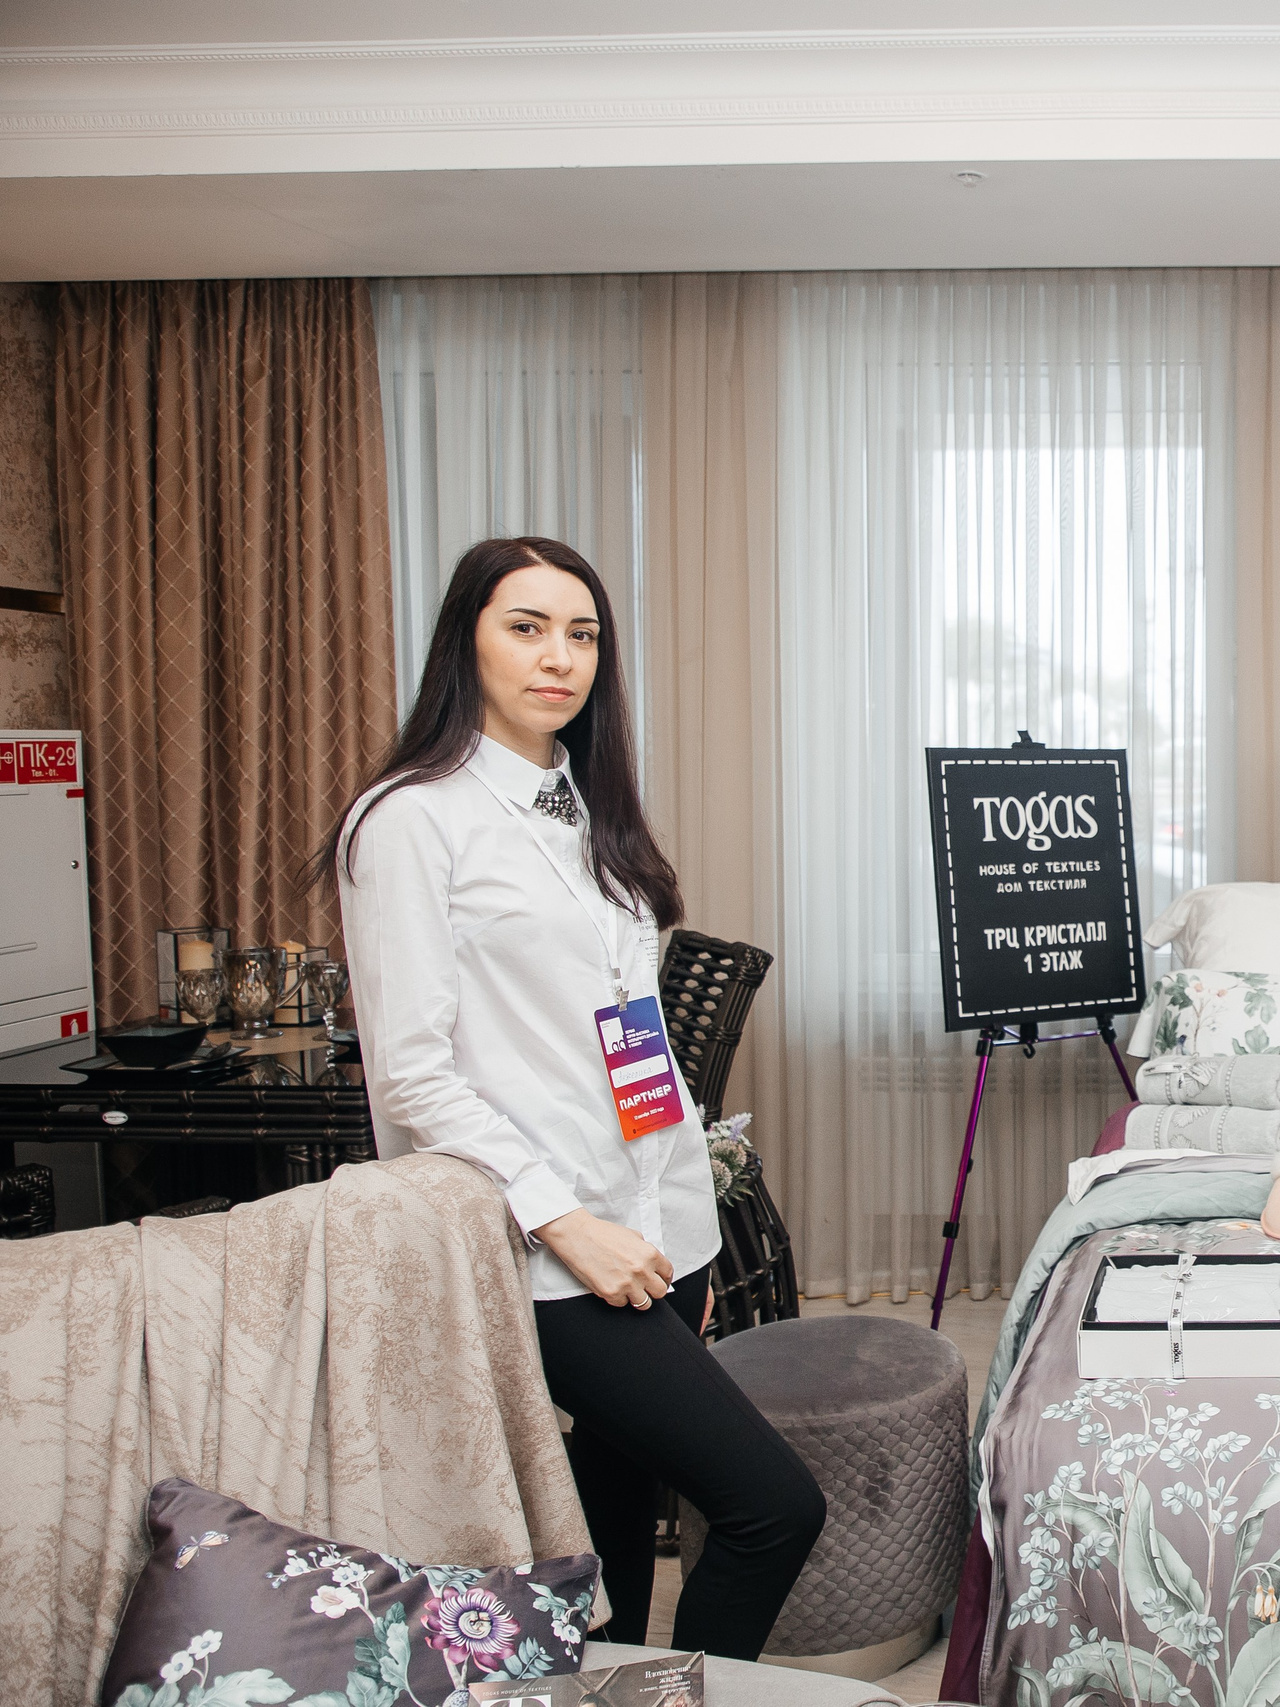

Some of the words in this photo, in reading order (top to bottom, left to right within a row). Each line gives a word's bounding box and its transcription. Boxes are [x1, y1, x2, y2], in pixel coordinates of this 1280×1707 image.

[19, 743, 76, 768] ПК-29
[979, 863, 1017, 876] HOUSE
[1022, 862, 1039, 875] OF
[1045, 860, 1101, 873] TEXTILES
[996, 882, 1023, 893] ДОМ
[1028, 878, 1087, 892] ТЕКСТИЛЯ
[983, 927, 1020, 950] ТРЦ
[1024, 921, 1107, 947] КРИСТАЛЛ
[1023, 953, 1033, 974] 1
[1039, 949, 1084, 973] ЭТАЖ
[619, 1084, 673, 1111] ПАРТНЕР
